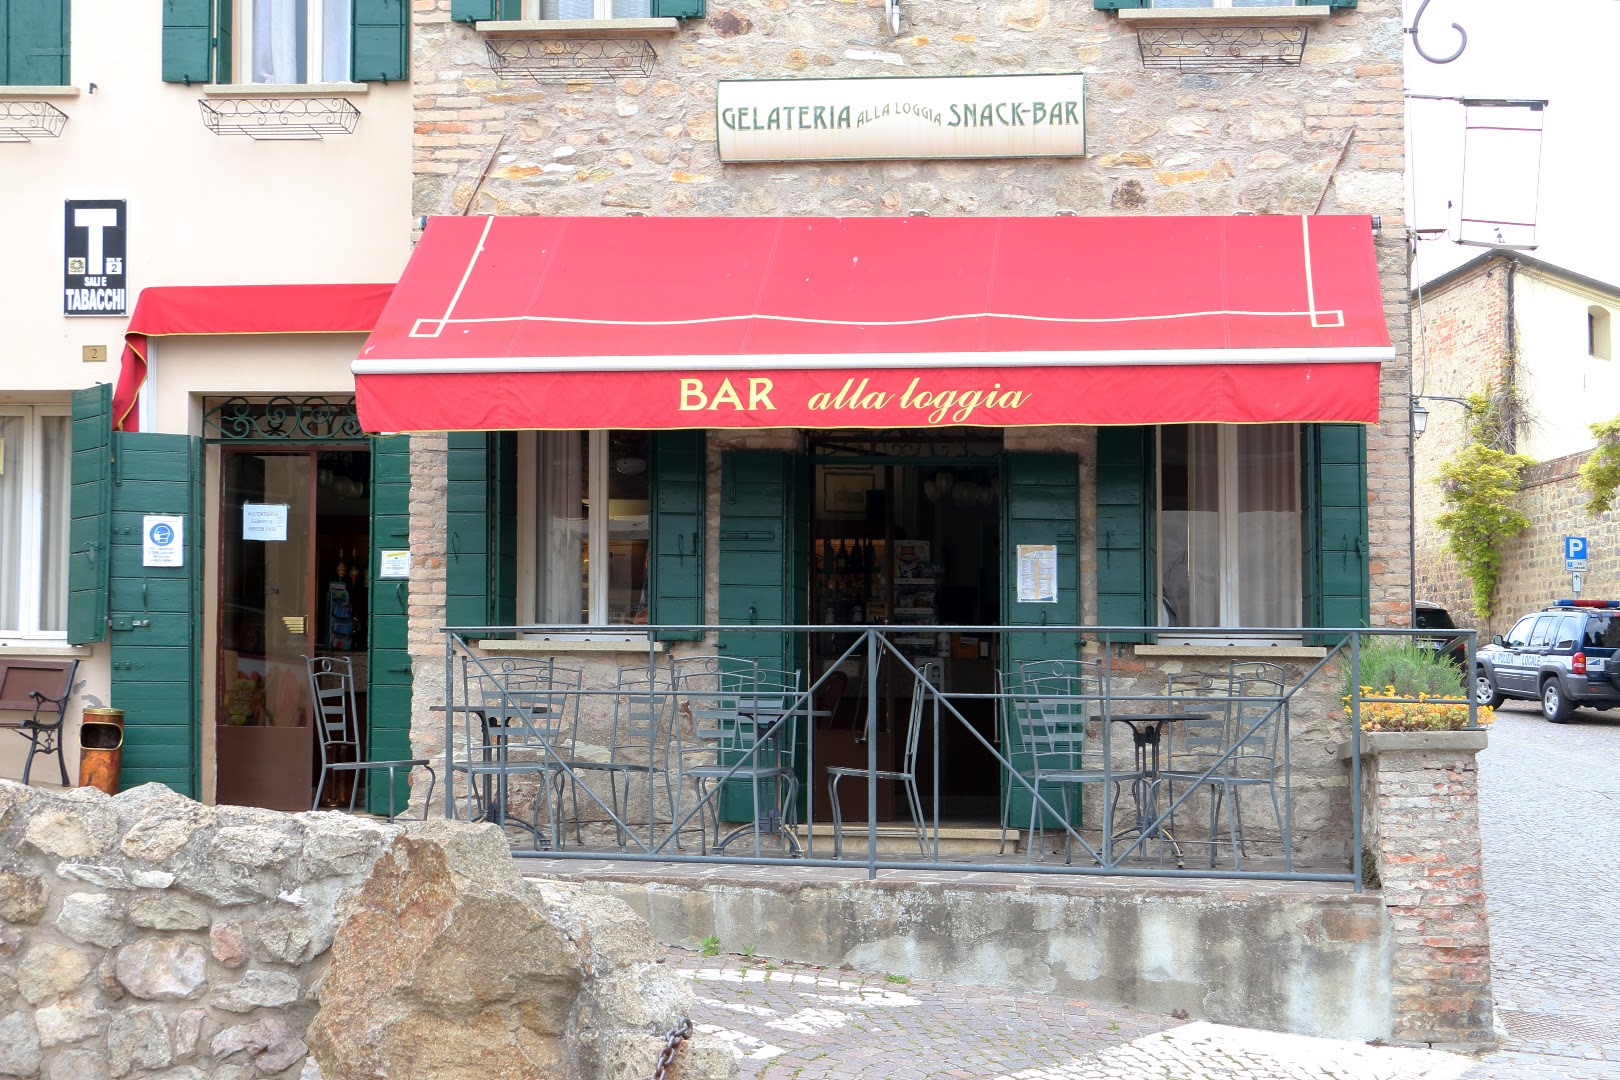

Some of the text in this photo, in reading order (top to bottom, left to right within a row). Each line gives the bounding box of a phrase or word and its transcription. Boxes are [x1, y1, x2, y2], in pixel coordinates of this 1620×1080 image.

[721, 101, 1080, 131] GELATERIA ALLA LOGGIA SNACK-BAR
[74, 208, 118, 275] T
[110, 263, 118, 273] 2
[84, 276, 107, 287] SALI E
[65, 288, 125, 310] TABACCHI
[91, 348, 98, 359] 2
[678, 376, 1033, 424] BAR alla loggia
[1569, 538, 1583, 558] P
[1498, 653, 1541, 666] POLIZIA LOCALE
